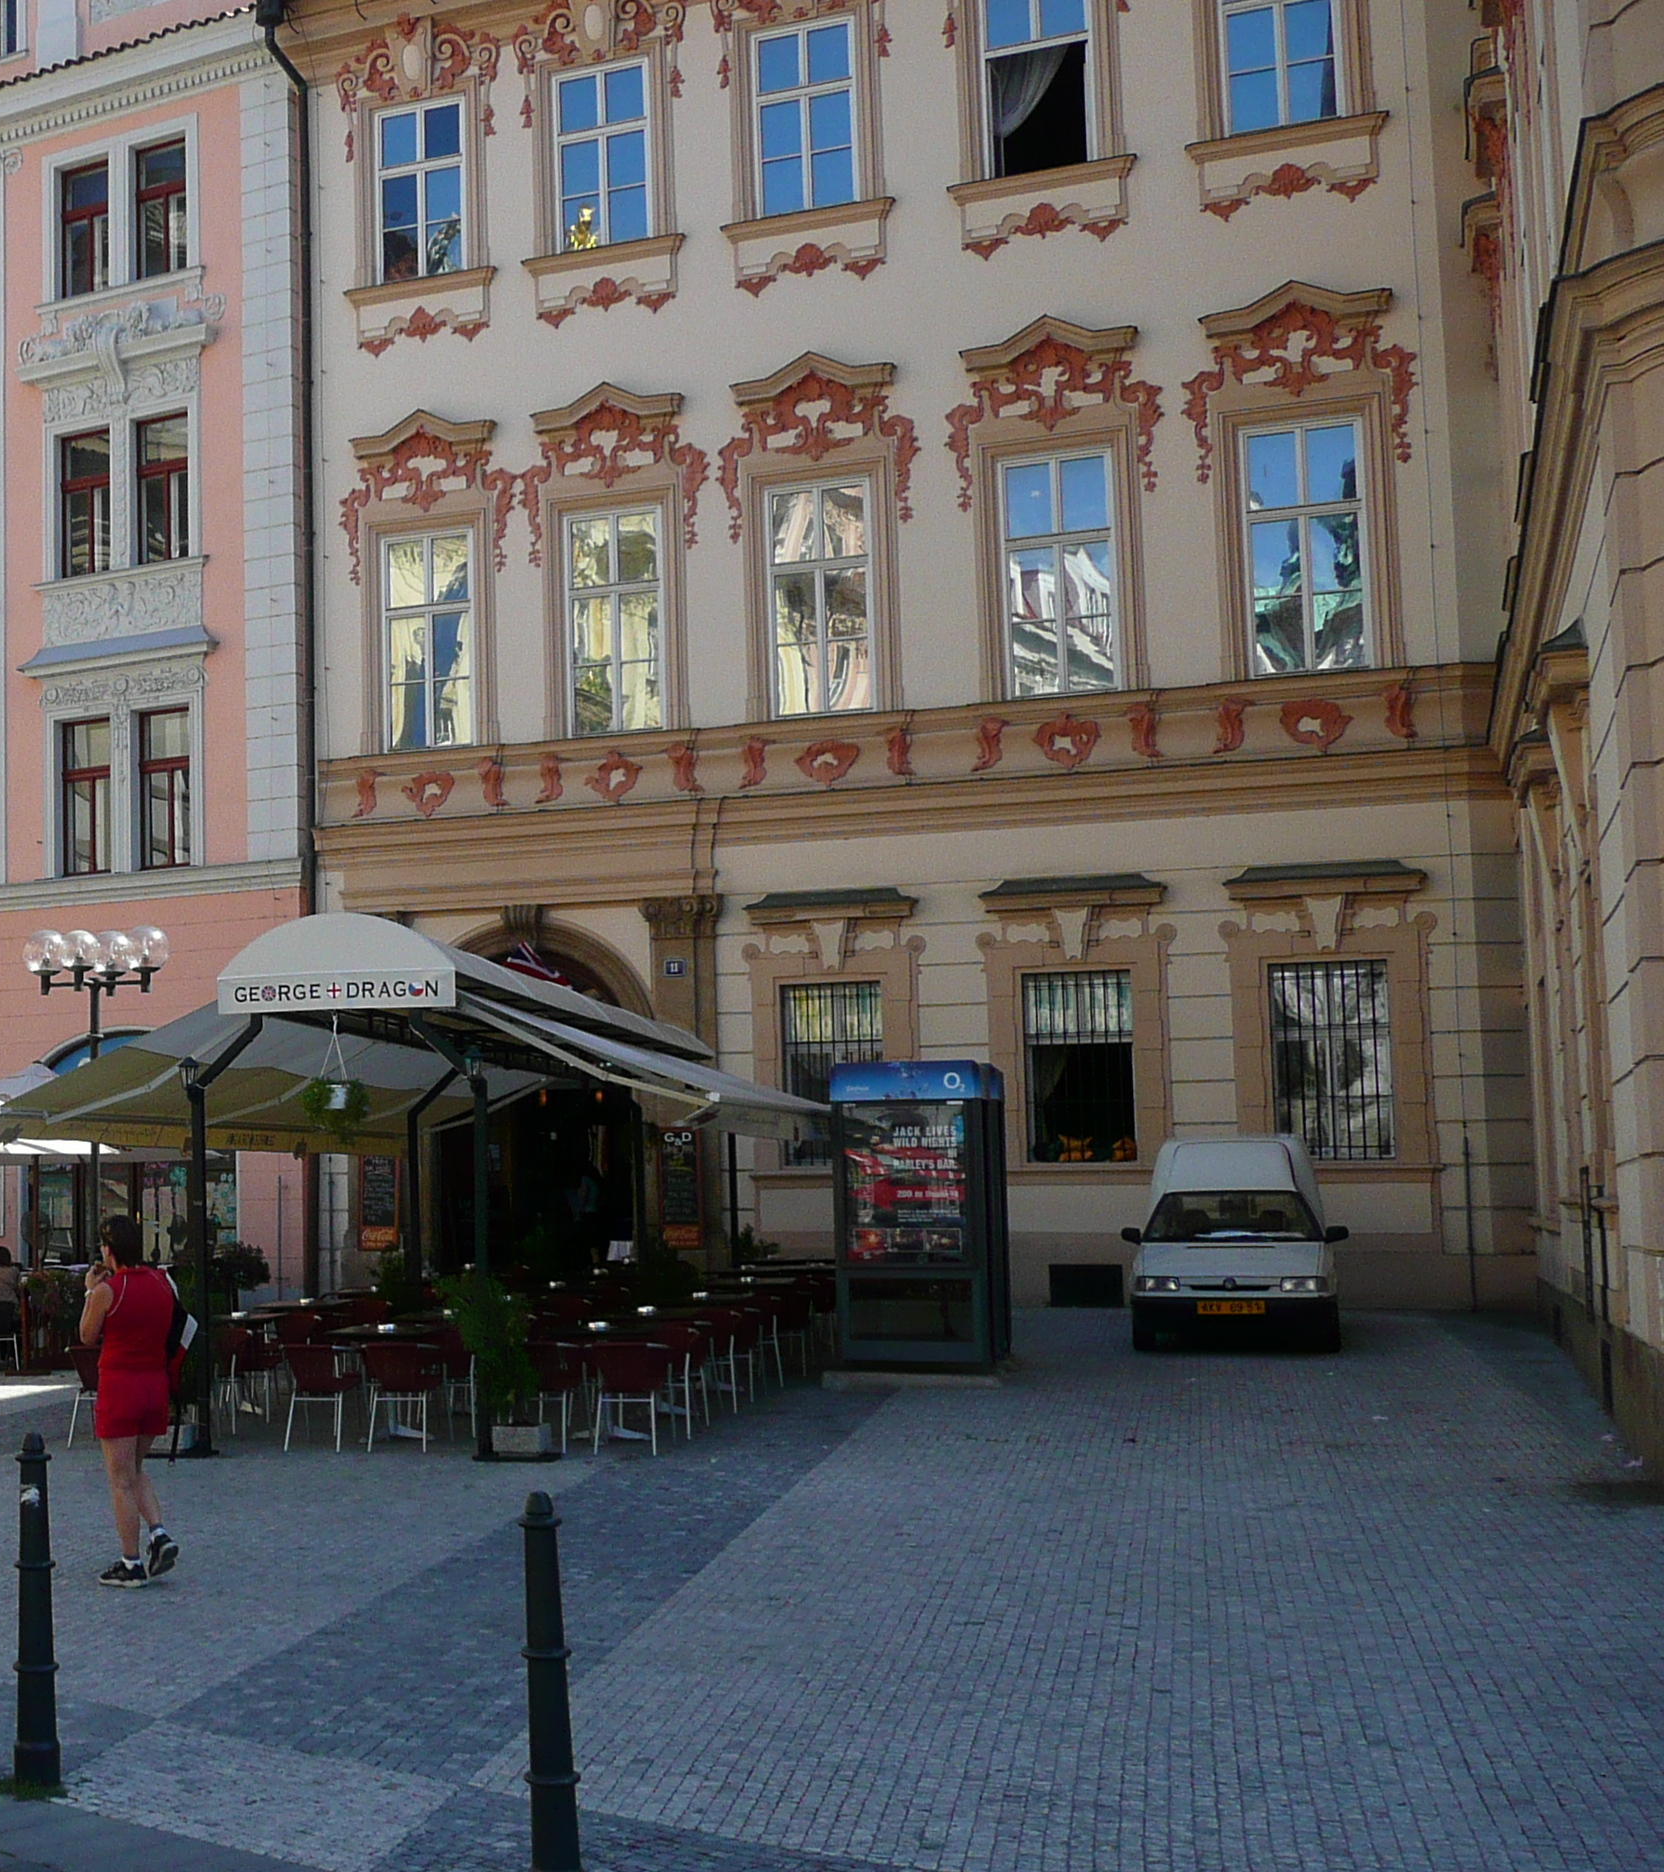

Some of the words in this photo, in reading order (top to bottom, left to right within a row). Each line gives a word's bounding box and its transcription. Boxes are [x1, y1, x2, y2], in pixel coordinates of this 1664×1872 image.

[670, 962, 678, 972] 11
[234, 983, 321, 1002] GEORGE
[346, 980, 439, 999] DRAGON
[893, 1126, 921, 1137] JACK
[926, 1125, 956, 1136] LIVES
